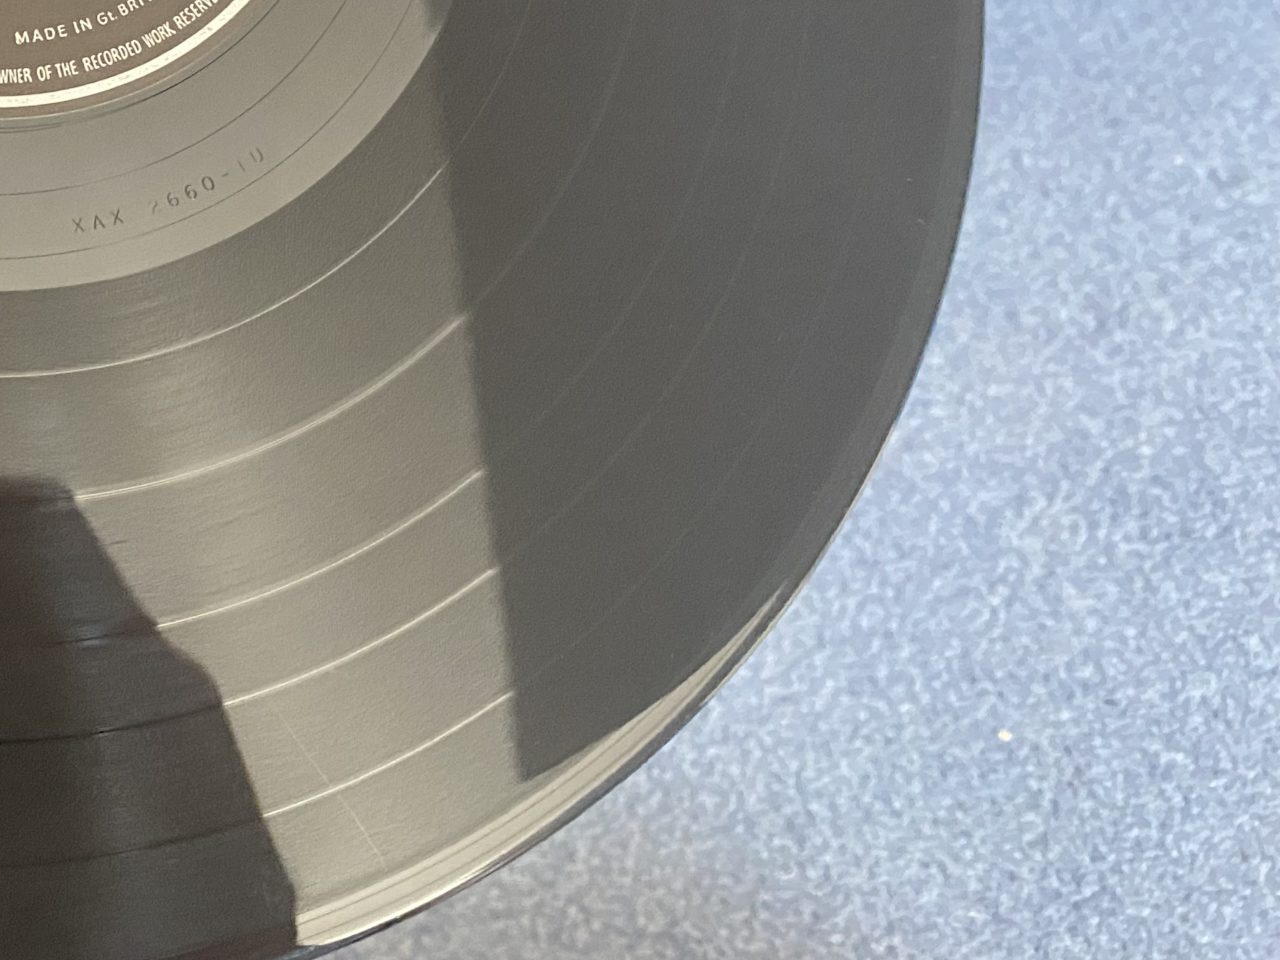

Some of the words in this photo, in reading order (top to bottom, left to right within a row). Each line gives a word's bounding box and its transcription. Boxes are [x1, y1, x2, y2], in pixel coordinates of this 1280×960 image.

[15, 24, 68, 45] MADE
[72, 17, 93, 34] IN
[36, 64, 53, 81] OF
[55, 59, 79, 78] THE
[82, 39, 142, 72] RECORDED
[141, 21, 177, 48] WORK
[72, 208, 124, 233] XAX
